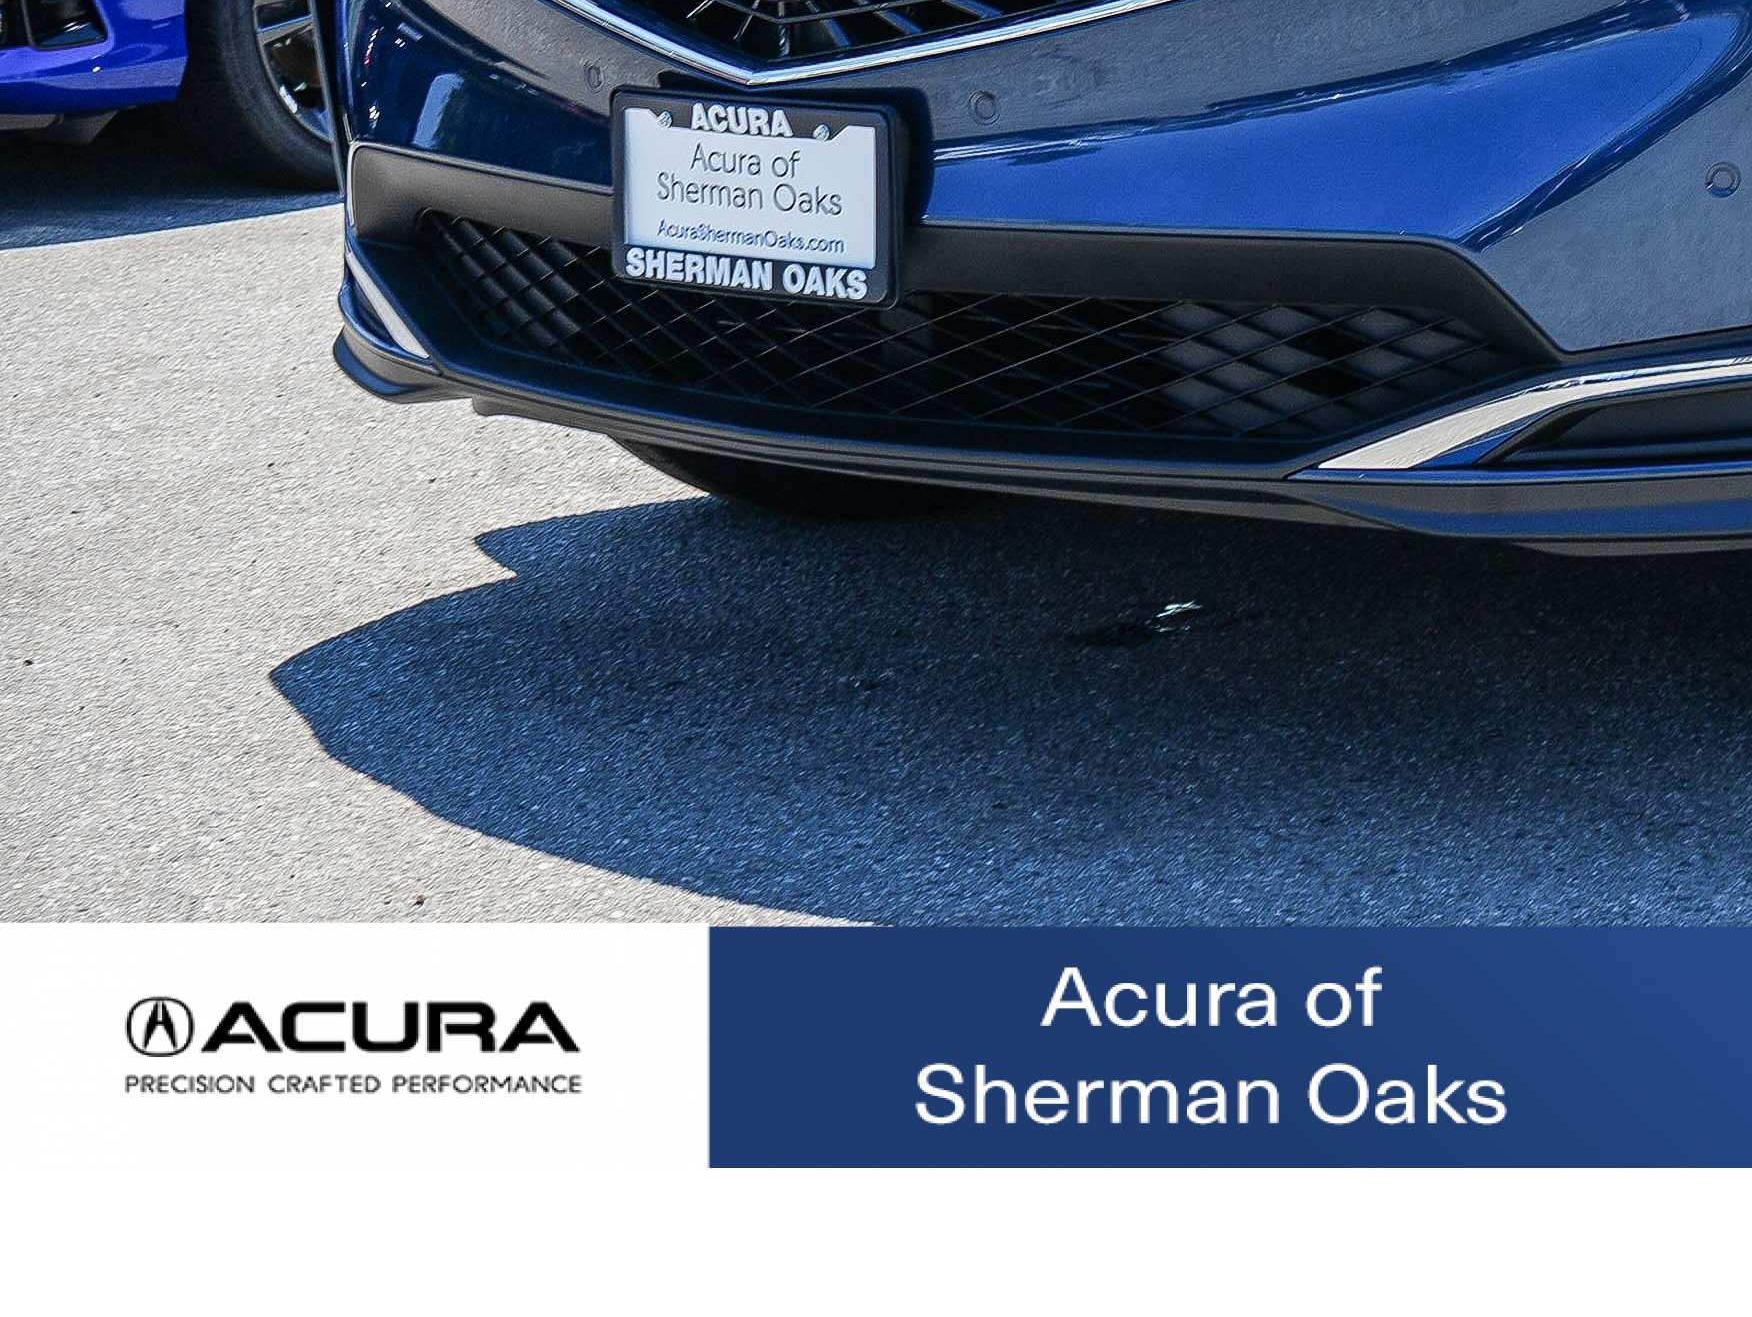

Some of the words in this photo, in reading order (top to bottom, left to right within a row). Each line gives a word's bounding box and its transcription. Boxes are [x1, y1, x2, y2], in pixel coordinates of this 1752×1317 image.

[691, 103, 793, 137] ACURA
[690, 143, 761, 177] Acura
[772, 150, 801, 178] of
[656, 170, 763, 210] Sherman
[773, 183, 842, 216] Oaks
[656, 219, 845, 253] AcuraShermanOaks.com
[625, 248, 773, 291] SHERMAN
[783, 264, 867, 299] OAKS
